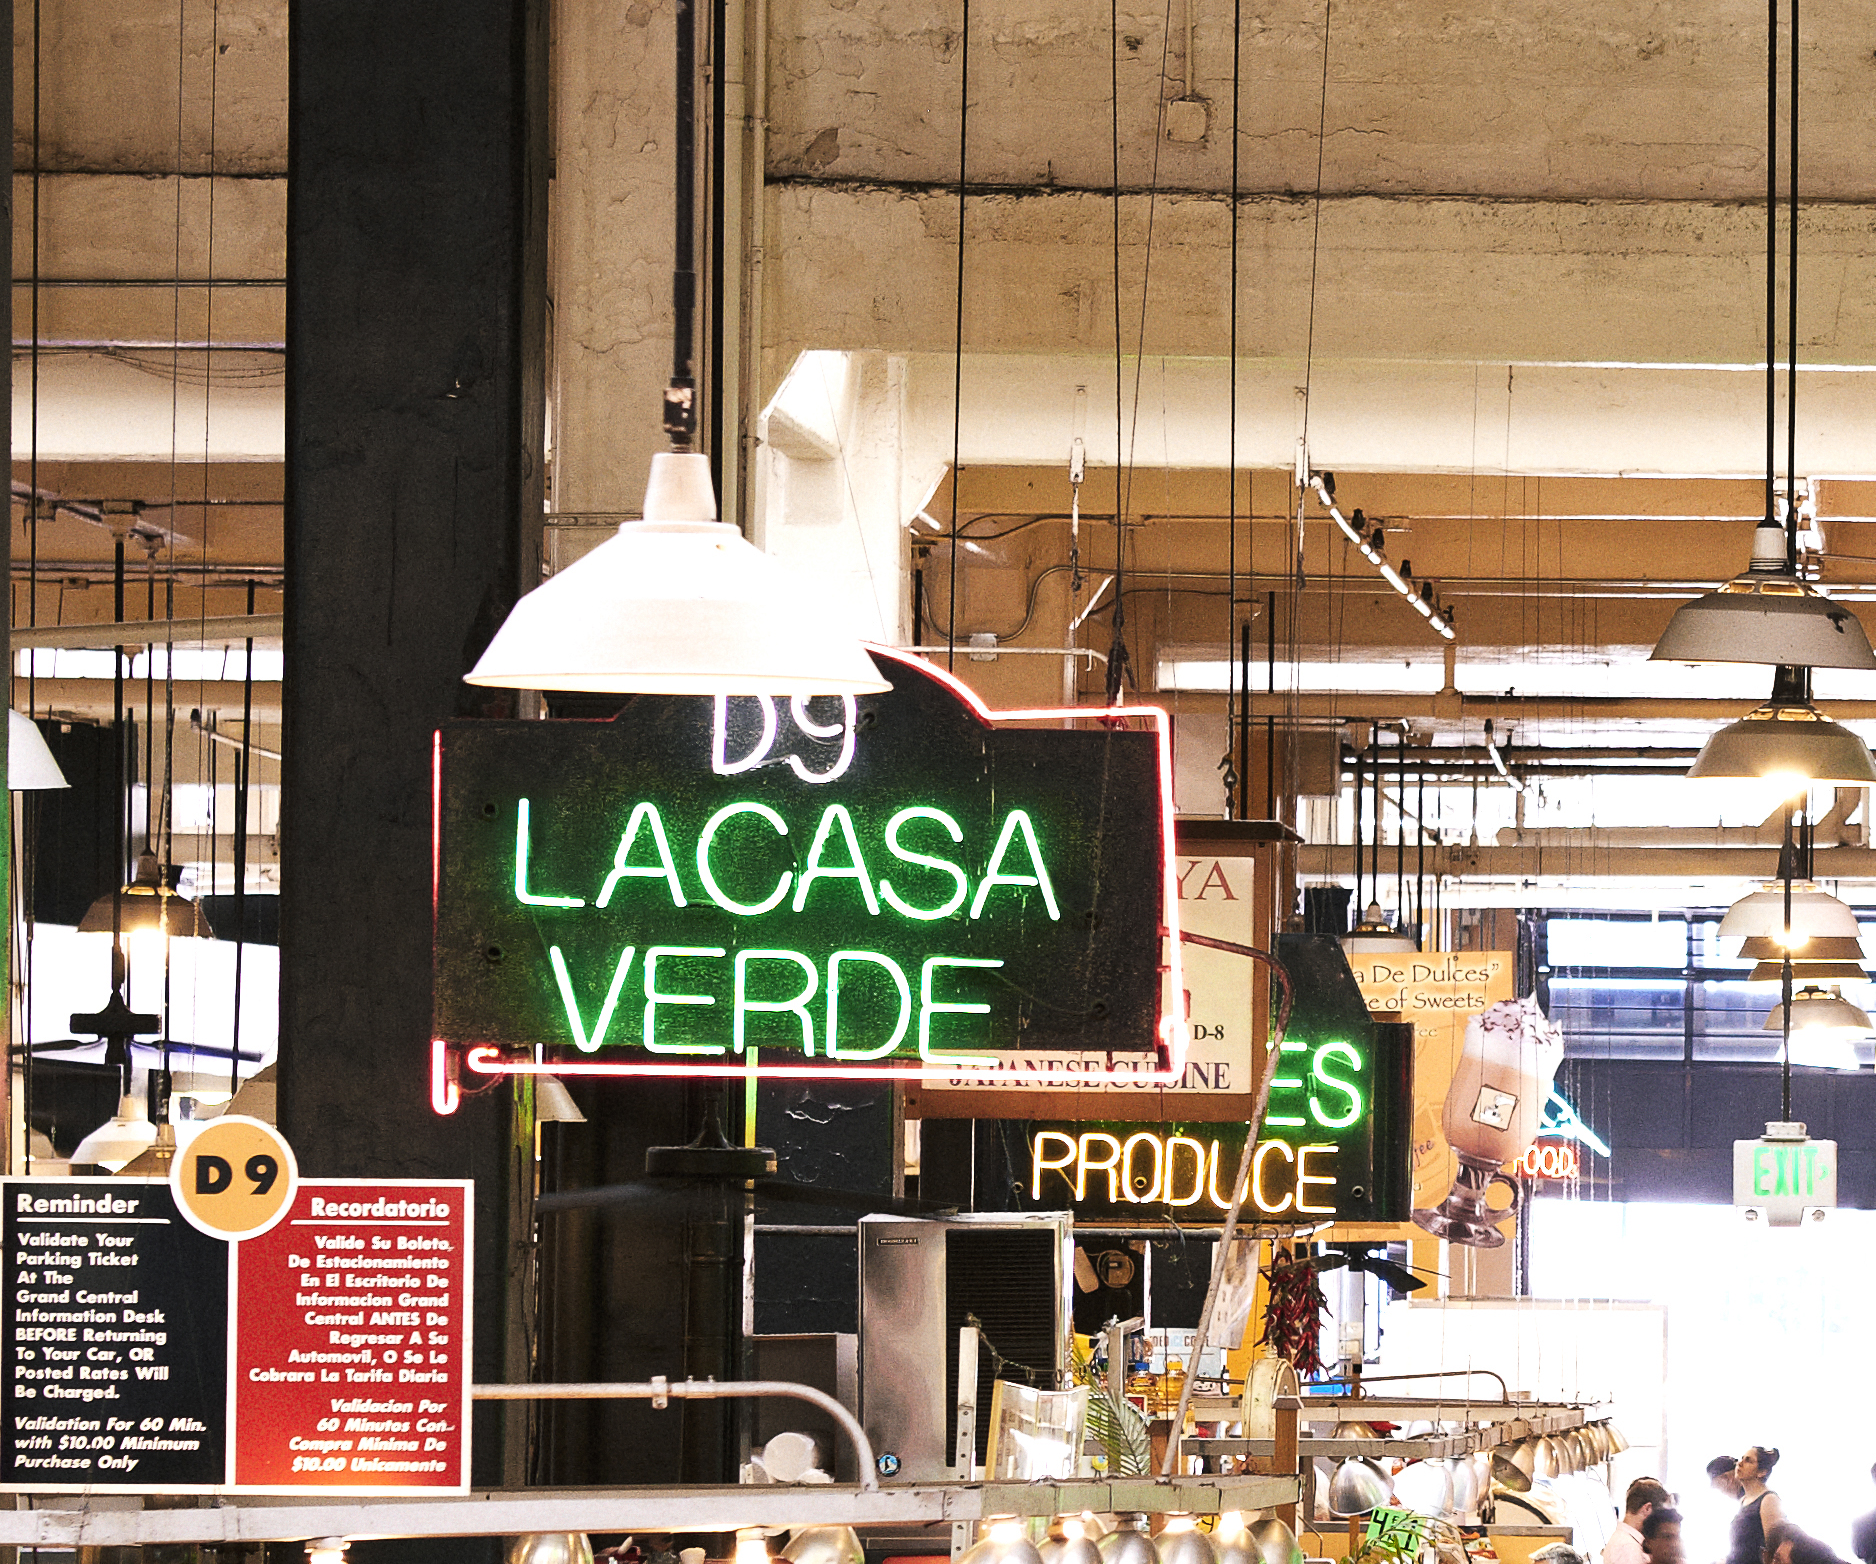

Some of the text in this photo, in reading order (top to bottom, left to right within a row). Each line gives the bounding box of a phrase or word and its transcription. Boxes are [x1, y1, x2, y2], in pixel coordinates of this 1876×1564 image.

[1373, 965, 1405, 983] De
[550, 944, 1005, 1067] VERDE
[1386, 988, 1408, 1009] of
[1413, 993, 1485, 1010] Sweets
[1194, 1024, 1225, 1041] D-8
[1032, 1131, 1340, 1216] PRODUCE
[1753, 1146, 1820, 1197] EXIT
[17, 1194, 140, 1214] Reminder
[311, 1197, 450, 1218] Recordatorio
[18, 1232, 135, 1248] Validate Your
[314, 1235, 366, 1250] Valide
[371, 1236, 392, 1250] Su
[17, 1251, 139, 1269] Parking Ticket
[288, 1254, 450, 1270] De Estacionamiento
[17, 1271, 74, 1285] At The
[300, 1273, 449, 1289] En El Escritorio De
[16, 1290, 139, 1304] Grand Central
[296, 1292, 449, 1307] Informacion Grand
[16, 1309, 165, 1324] Information Desk
[304, 1311, 449, 1326] Central ANTES De
[16, 1328, 167, 1346] BEFORE Returning
[329, 1330, 449, 1348] Regresar A Su
[15, 1347, 155, 1364] To Your Car, OR
[288, 1349, 449, 1366] Automovil, O Se Le
[15, 1366, 170, 1381] Posted Rates Will
[249, 1368, 448, 1383] Cobrara La Tarifa Diaria
[15, 1385, 120, 1402] Be Charged.
[330, 1398, 448, 1414] Validacion Por
[15, 1416, 207, 1432] Validation For 60 Min.
[316, 1417, 341, 1432] 60
[344, 1417, 411, 1433] Minutos
[15, 1435, 200, 1451] with $10.00 Minimum
[288, 1436, 447, 1454] Compra Minima De
[14, 1455, 139, 1473] Purchase Only
[291, 1456, 447, 1473] $10.00 Unicamente
